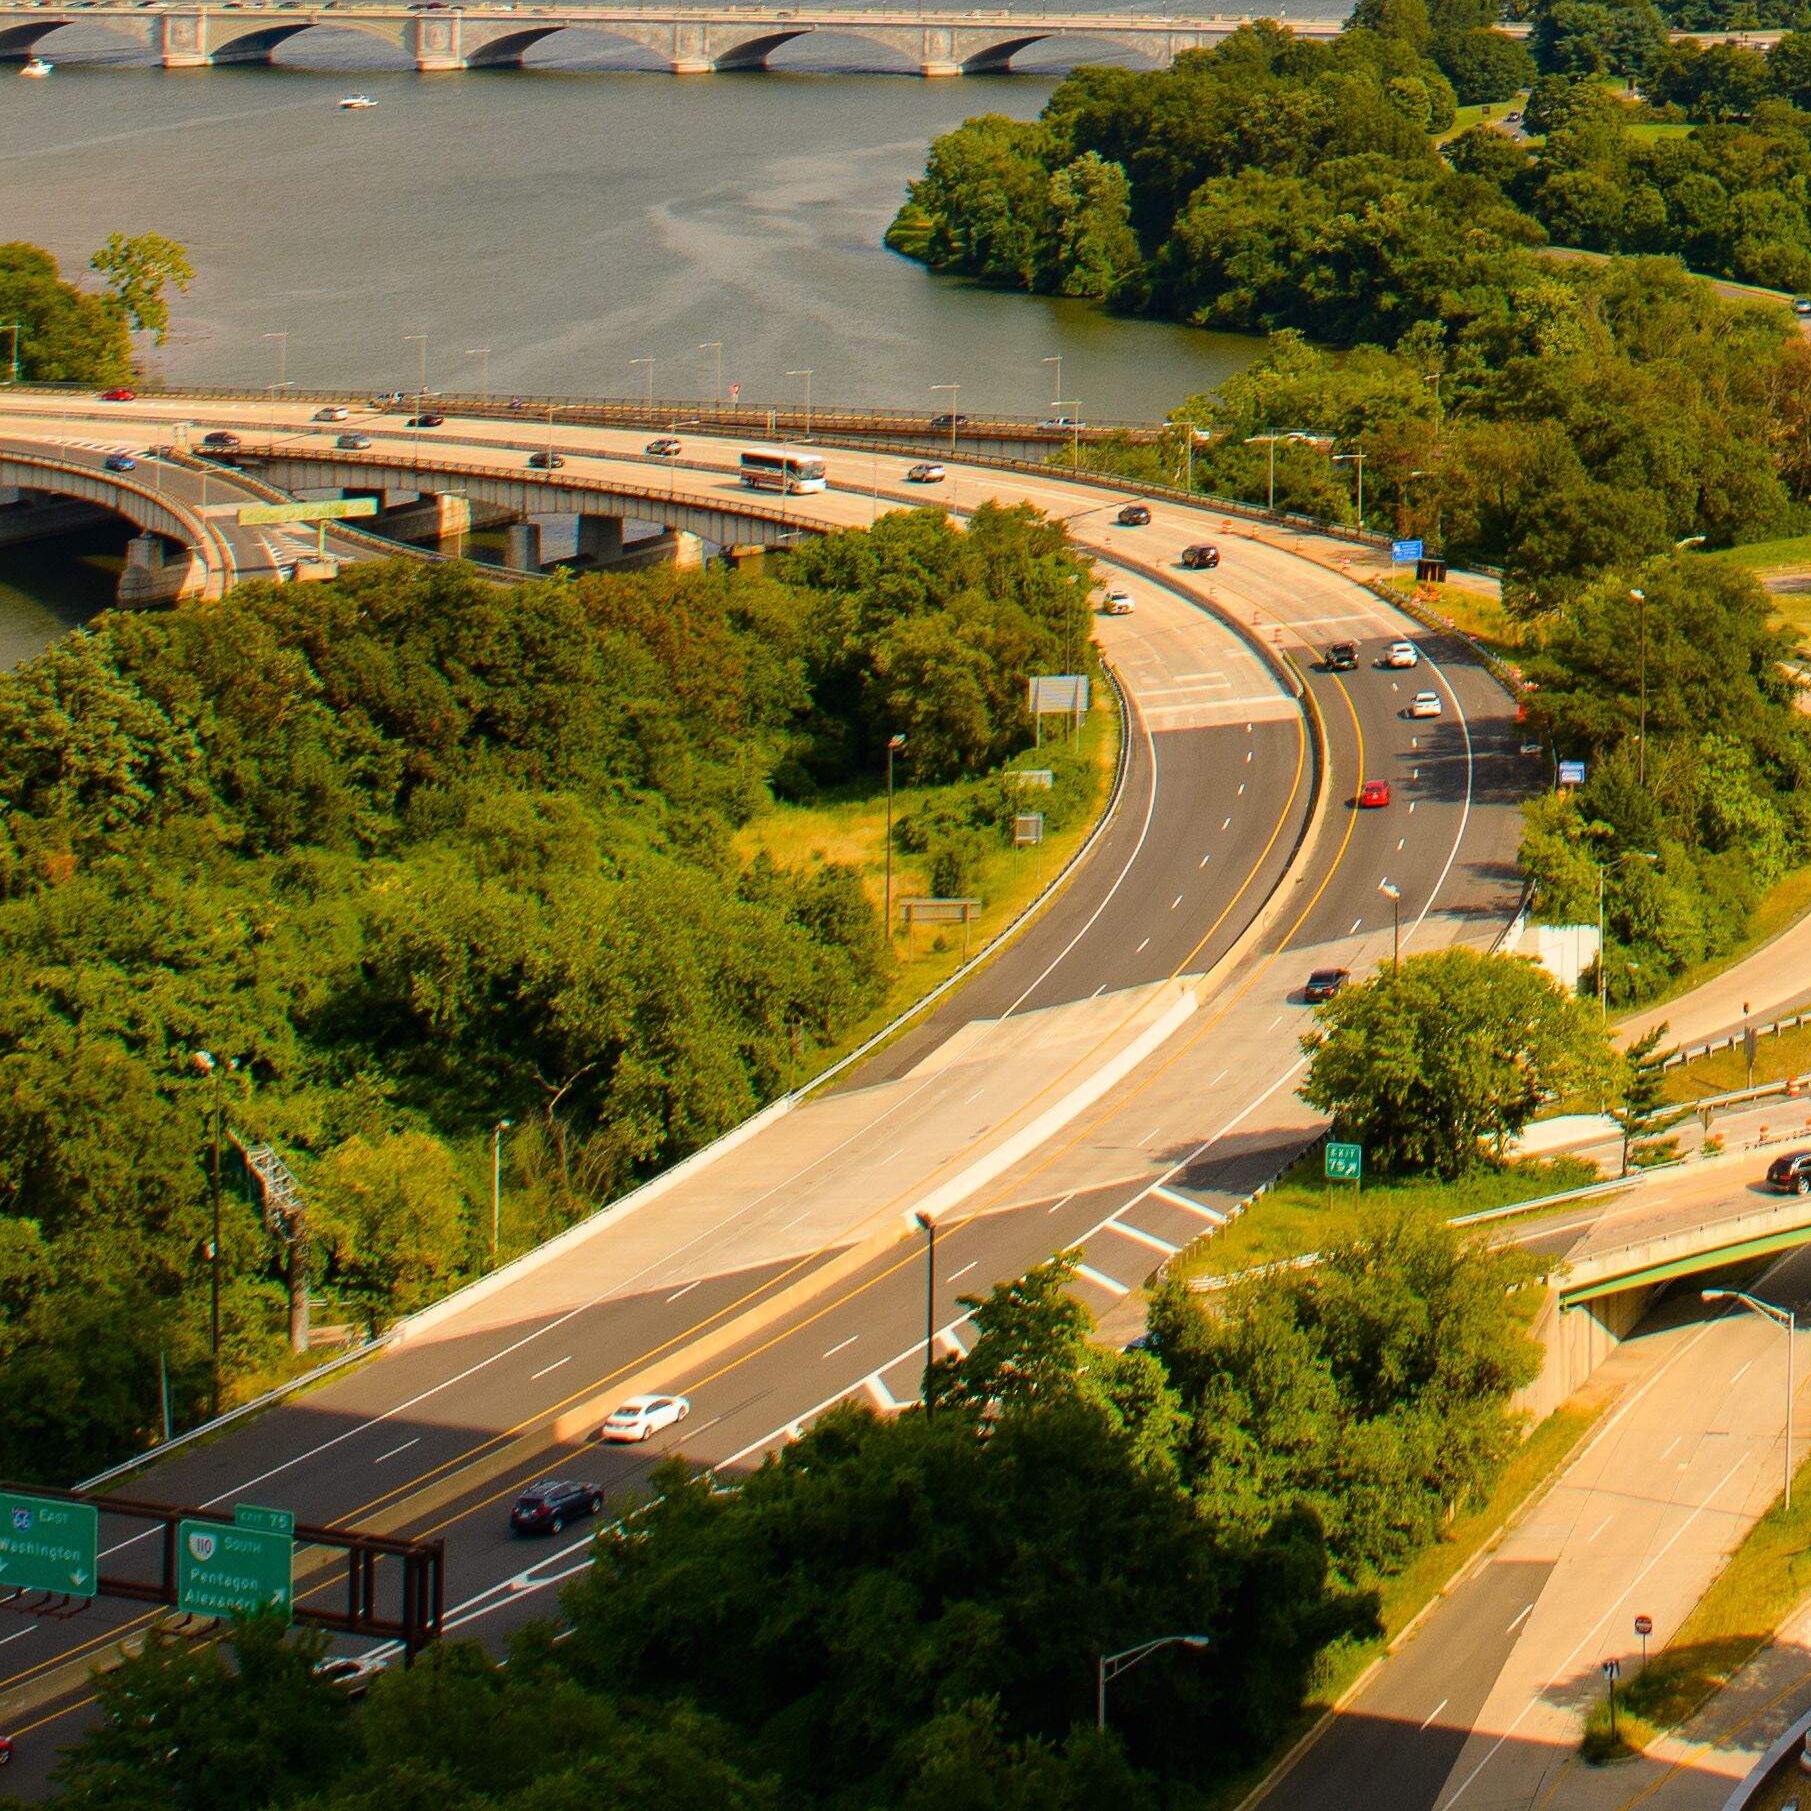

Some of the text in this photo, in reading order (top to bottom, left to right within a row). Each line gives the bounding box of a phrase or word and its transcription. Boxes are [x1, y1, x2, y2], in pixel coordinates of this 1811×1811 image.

[270, 1513, 288, 1529] 75
[0, 1537, 80, 1562] Washington
[196, 1537, 213, 1554] 110
[190, 1567, 258, 1592] Pentagon
[184, 1588, 257, 1612] Alexandri
